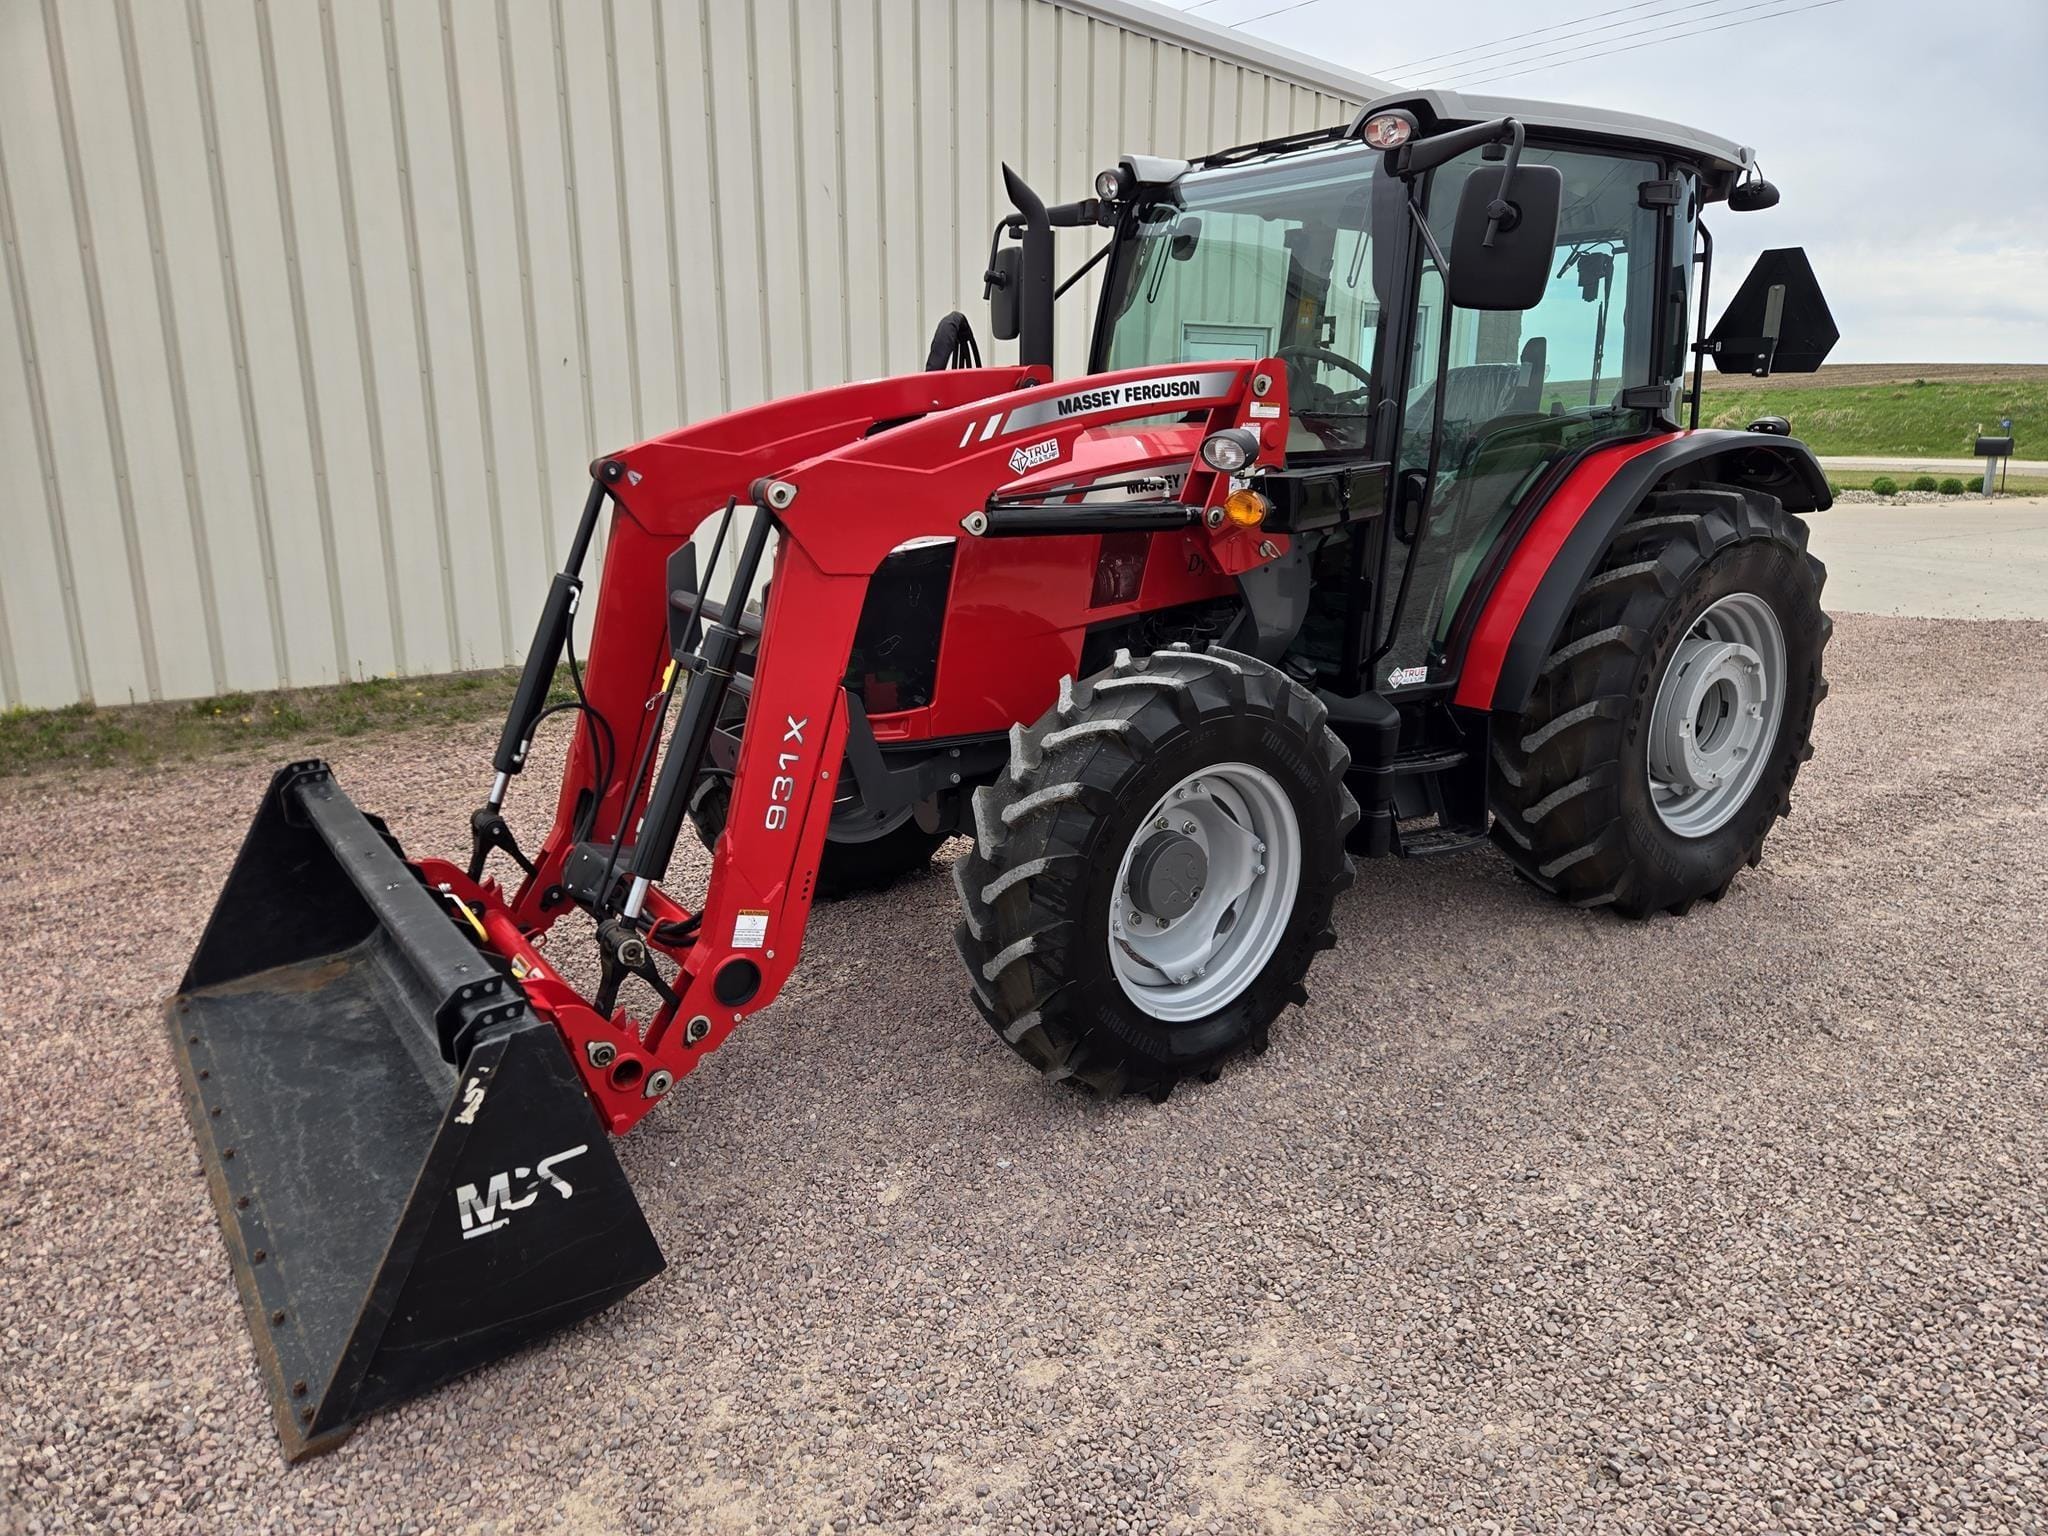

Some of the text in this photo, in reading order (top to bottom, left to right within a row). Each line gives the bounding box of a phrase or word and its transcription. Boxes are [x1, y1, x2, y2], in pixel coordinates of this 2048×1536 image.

[1057, 380, 1201, 416] MASSEY FERGUSON
[1028, 440, 1057, 459] TRUE
[1404, 669, 1425, 678] TRUE
